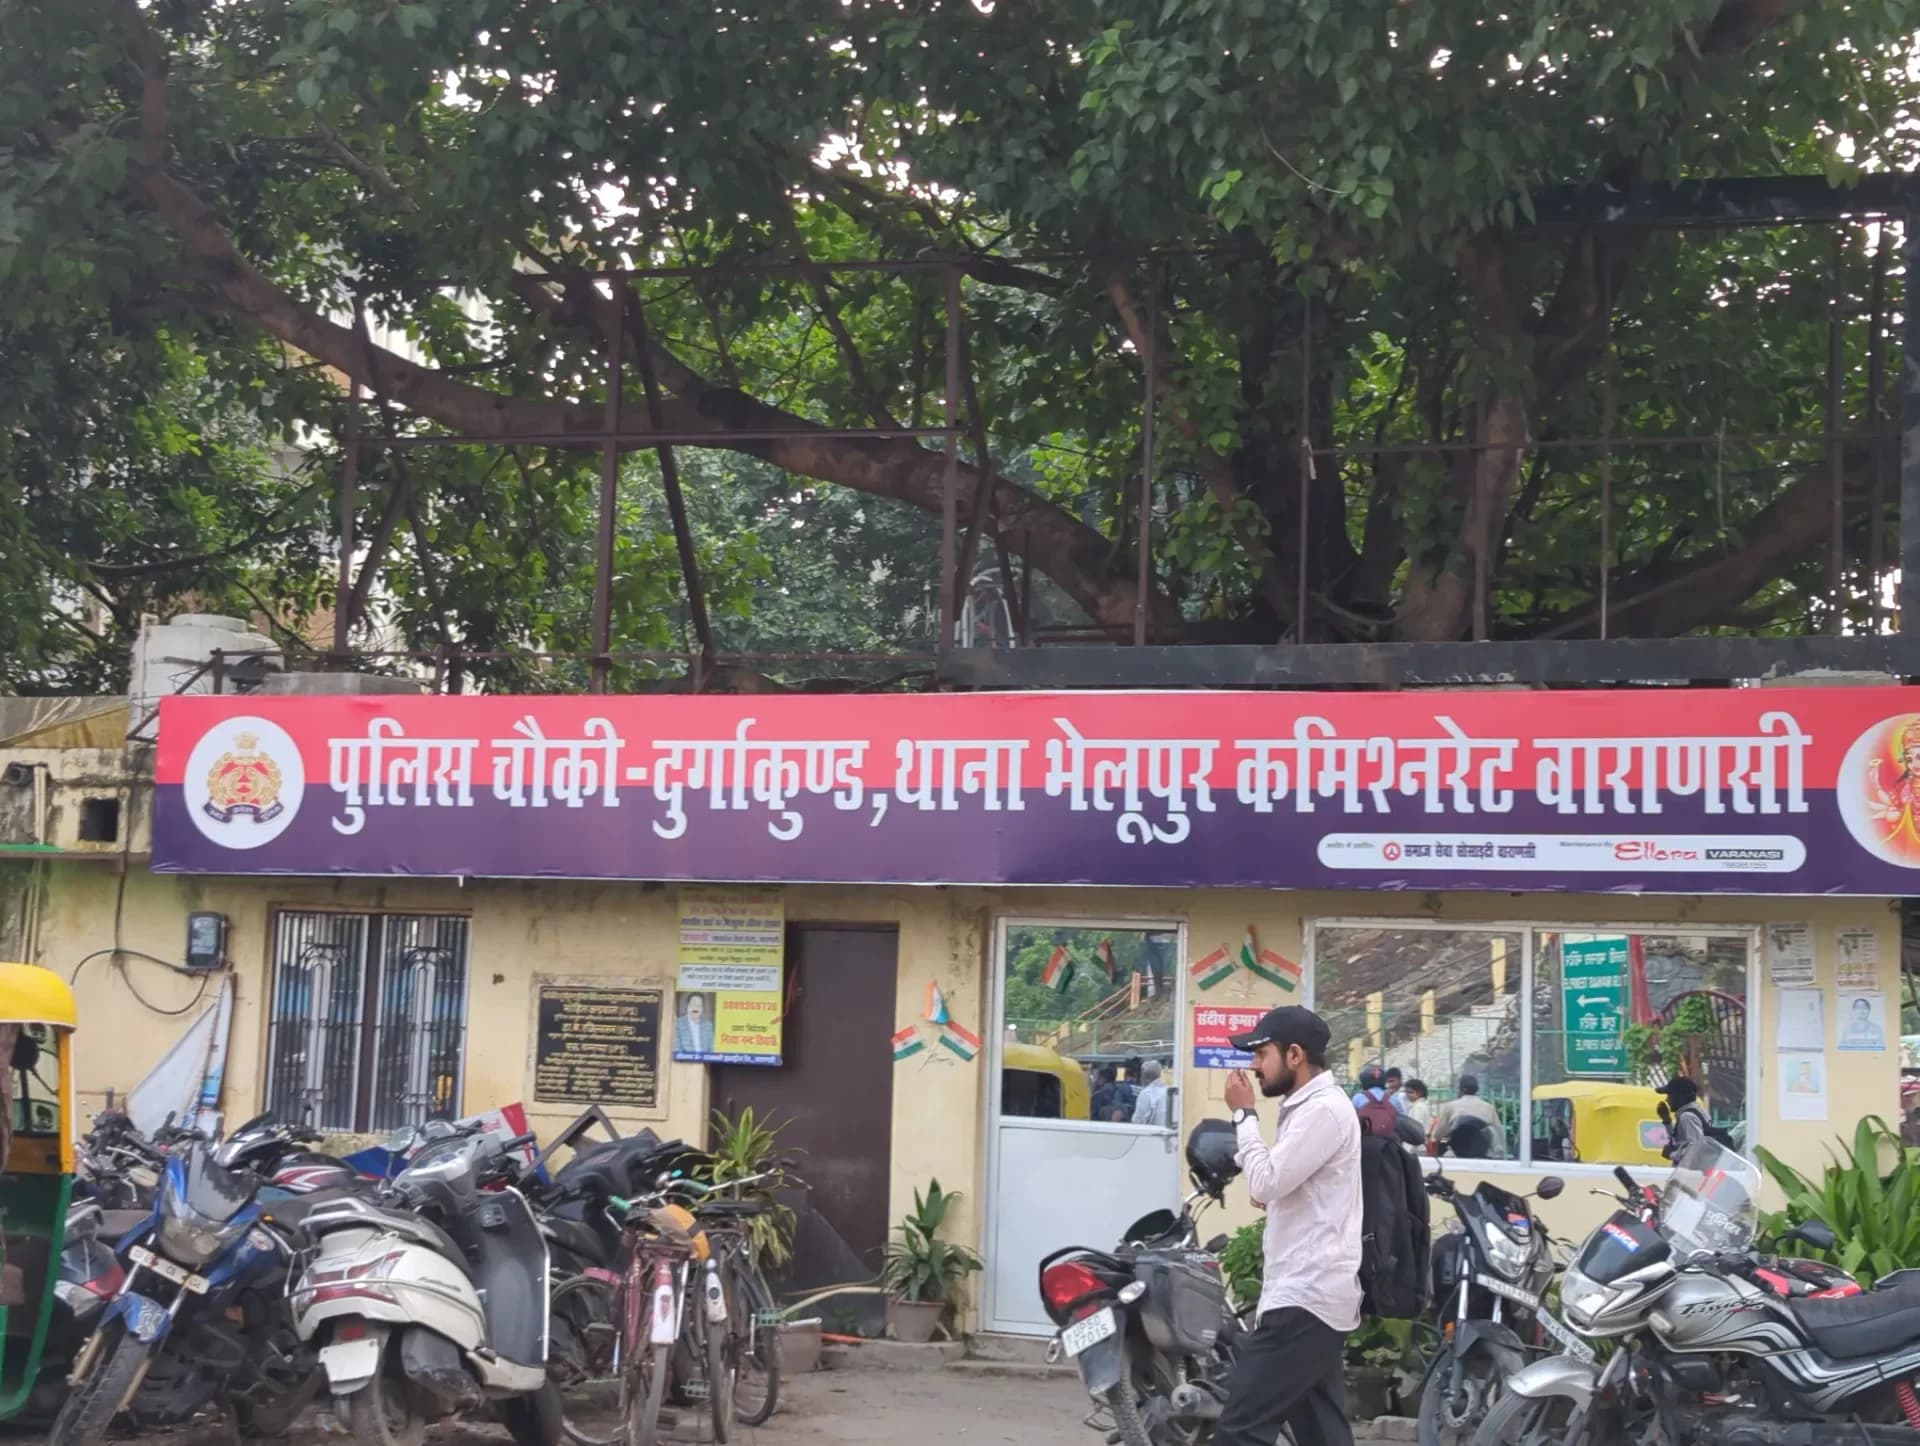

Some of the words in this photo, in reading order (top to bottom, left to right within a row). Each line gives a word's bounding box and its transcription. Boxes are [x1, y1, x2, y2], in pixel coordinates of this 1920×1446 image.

[328, 717, 478, 834] पुलिस
[1045, 717, 1220, 844] भेलूपुर
[1234, 715, 1519, 813] कमिश्नरेट
[1533, 711, 1812, 814] वाराणसी
[1614, 841, 1699, 861] Ellora
[1708, 850, 1782, 859] VARANASI
[1197, 1010, 1226, 1026] संदीप
[1228, 1014, 1257, 1031] कुमार
